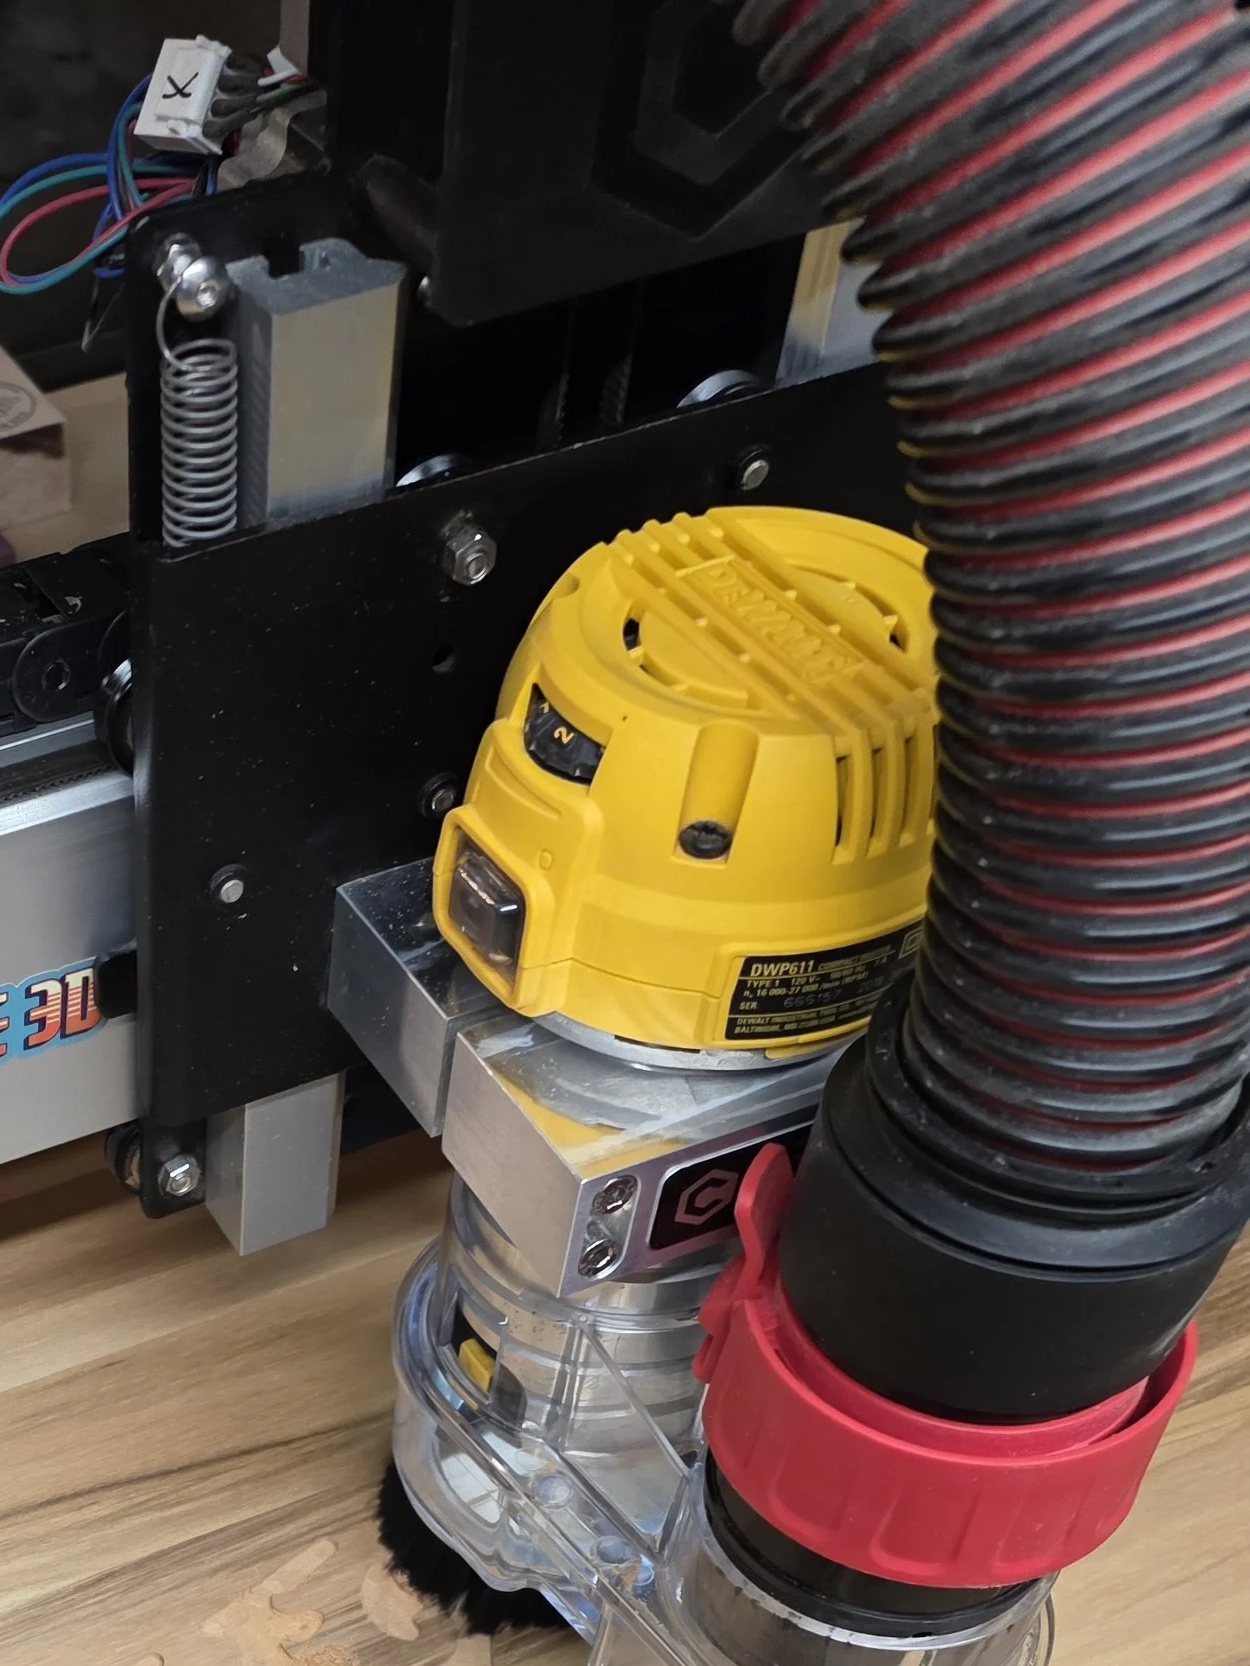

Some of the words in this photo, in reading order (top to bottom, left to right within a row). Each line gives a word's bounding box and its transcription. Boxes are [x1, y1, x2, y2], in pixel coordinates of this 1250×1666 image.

[162, 71, 199, 100] X
[554, 726, 575, 744] 2
[750, 959, 814, 977] DWP611
[747, 980, 773, 988] TYPE
[23, 967, 102, 1050] 3D
